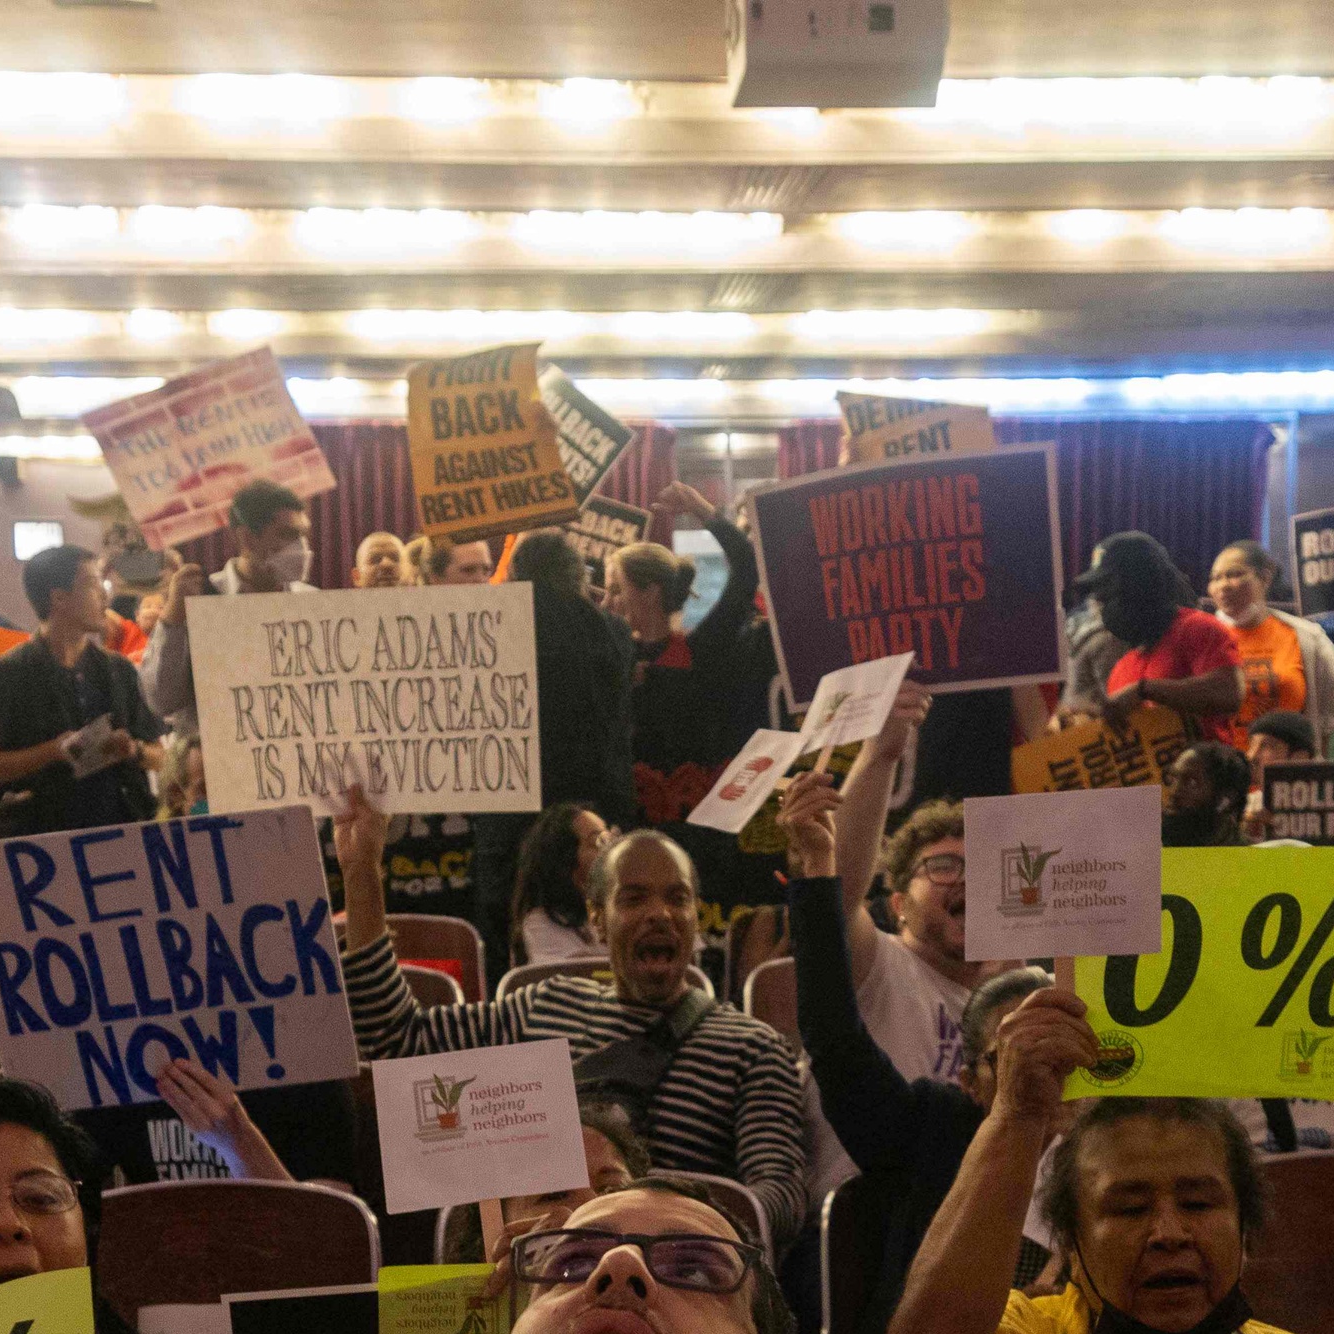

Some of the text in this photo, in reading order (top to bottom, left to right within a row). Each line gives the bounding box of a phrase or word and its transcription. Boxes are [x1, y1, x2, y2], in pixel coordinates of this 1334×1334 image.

[431, 388, 526, 441] BACK
[434, 441, 539, 487] AGAINST
[421, 469, 571, 526] RENT HIKES
[809, 473, 984, 557] WORKING
[820, 538, 986, 621] FAMILIES
[263, 609, 503, 677] ERIC ADAMS'
[847, 606, 964, 671] PARTY
[230, 671, 533, 743] RENT INCREASE
[251, 734, 531, 801] IS MY EVICTION
[3, 816, 244, 933] RENT
[1052, 858, 1127, 875] neighbors
[1052, 877, 1107, 894] helping
[1052, 893, 1128, 911] neighbors
[75, 1004, 287, 1107] NOW!
[468, 1079, 543, 1101] neighbors
[470, 1098, 526, 1117] helping
[472, 1111, 548, 1132] neighbors
